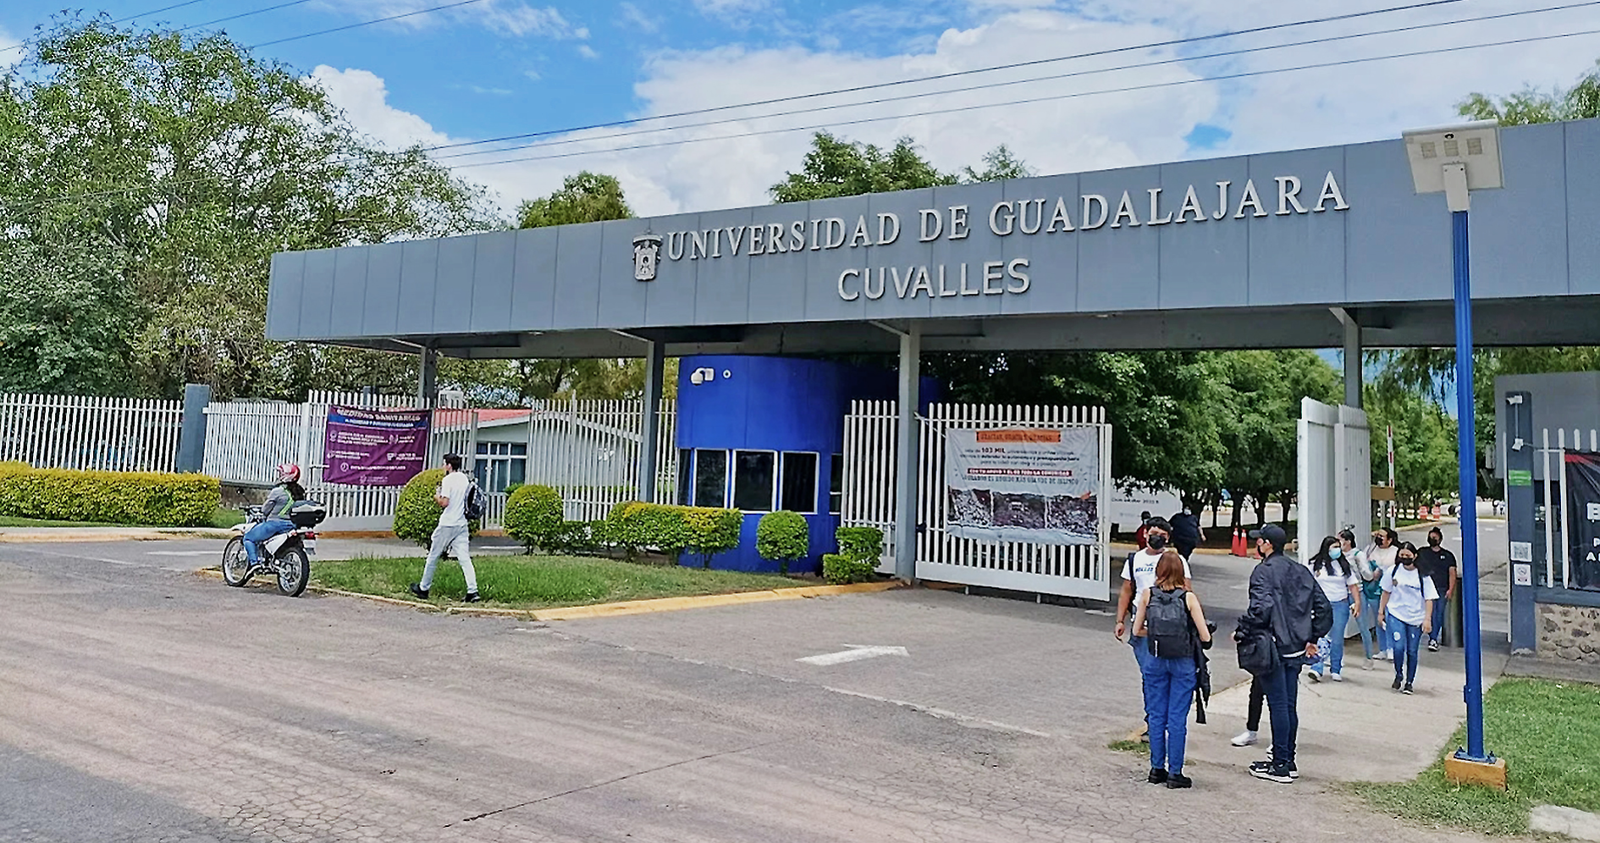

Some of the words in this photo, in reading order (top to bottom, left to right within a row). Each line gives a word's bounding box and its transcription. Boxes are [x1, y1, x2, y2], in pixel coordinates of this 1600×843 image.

[667, 212, 901, 261] UNIVERSIDAD
[918, 204, 971, 243] DE
[988, 170, 1350, 237] GUADALAJARA
[837, 257, 1031, 301] CUVALLES
